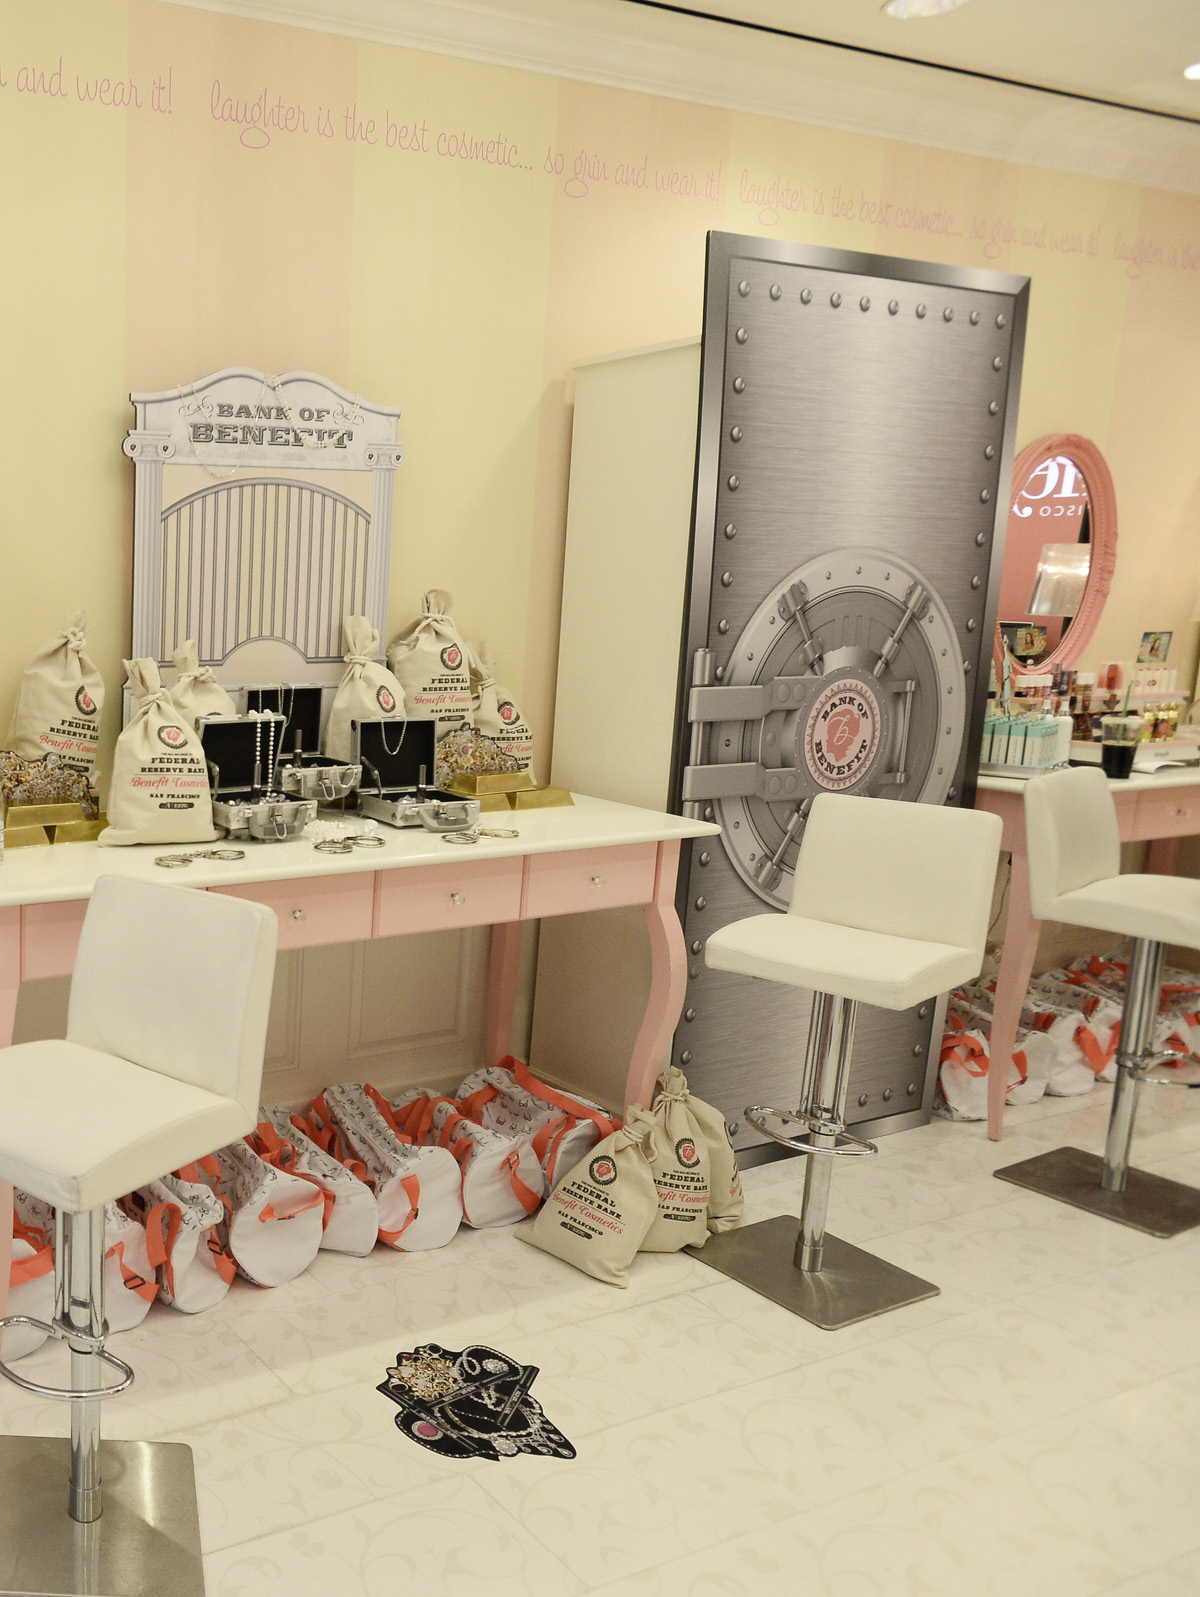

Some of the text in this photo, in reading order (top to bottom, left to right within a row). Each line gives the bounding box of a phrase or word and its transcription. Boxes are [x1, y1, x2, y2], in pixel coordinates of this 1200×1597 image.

[16, 56, 68, 97] and
[76, 74, 143, 109] wear
[150, 66, 174, 114] it!
[210, 79, 723, 202] laughter is the best cosmetic... so grin and wear it!
[739, 168, 808, 226] laughter
[812, 188, 825, 216] is
[831, 185, 856, 220] the
[859, 190, 892, 225] best
[216, 402, 331, 422] BANK OF
[188, 422, 354, 449] BENEFIT
[821, 696, 869, 722] BANK OF
[39, 734, 74, 751] Benefit
[814, 739, 868, 776] BENEFIT
[131, 776, 169, 790] Benefit
[661, 1171, 705, 1183] FEDERAL
[562, 1186, 595, 1206] RESERVE
[596, 1203, 622, 1220] BANK
[570, 1181, 616, 1208] FEDERAL
[569, 1216, 604, 1236] FRANCISCO
[579, 1205, 624, 1235] Cosmetics
